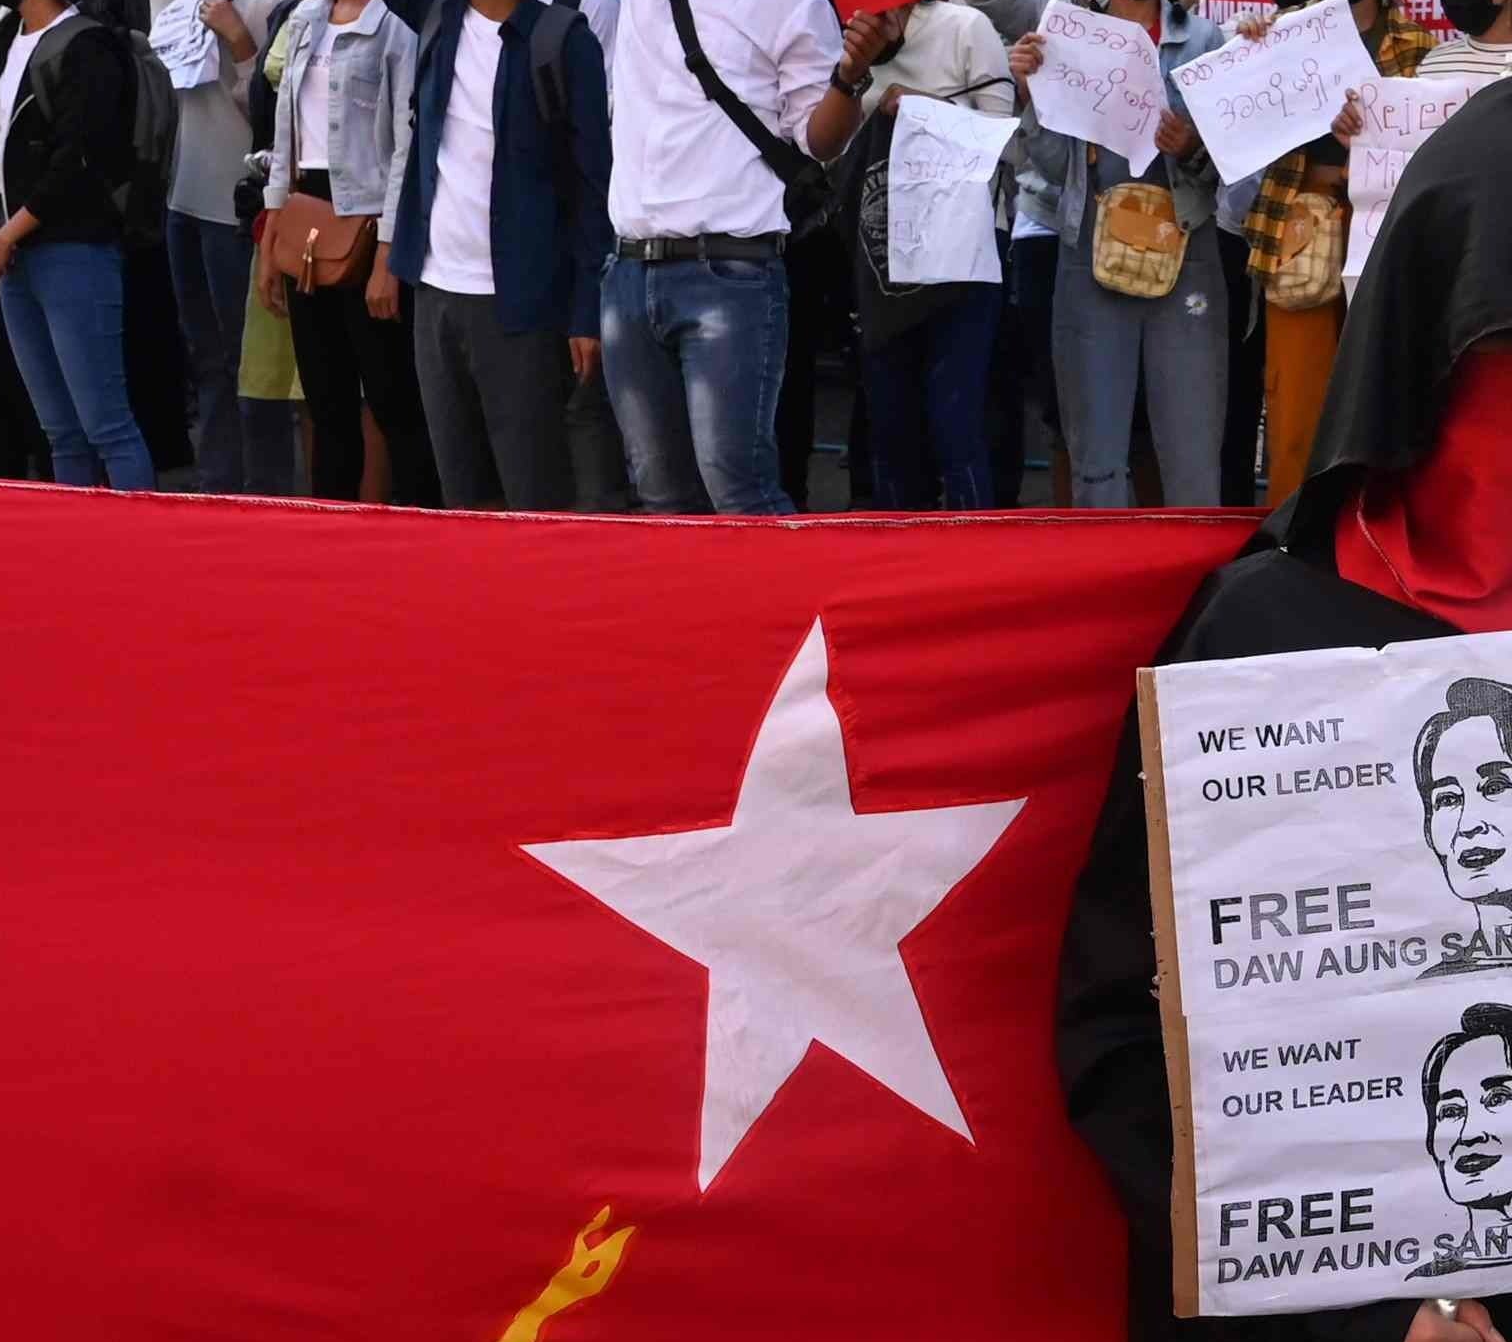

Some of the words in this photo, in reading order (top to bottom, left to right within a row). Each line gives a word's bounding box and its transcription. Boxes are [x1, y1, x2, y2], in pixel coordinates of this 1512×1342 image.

[1198, 726, 1245, 753] WE
[1255, 718, 1345, 749] WANT
[1202, 773, 1267, 802] OUR
[1276, 762, 1397, 796] LEADER
[1210, 882, 1376, 946] FREE
[1214, 951, 1303, 990] DAW
[1316, 939, 1428, 978] AUNG
[1223, 1048, 1269, 1073] WE
[1277, 1038, 1361, 1069] WANT
[1221, 1089, 1284, 1119] OUR
[1292, 1075, 1404, 1111] LEADER
[1219, 1187, 1375, 1247] FREE
[1217, 1249, 1302, 1285] DAW
[1313, 1238, 1421, 1276] AUNG
[1433, 1228, 1509, 1262] SAN
